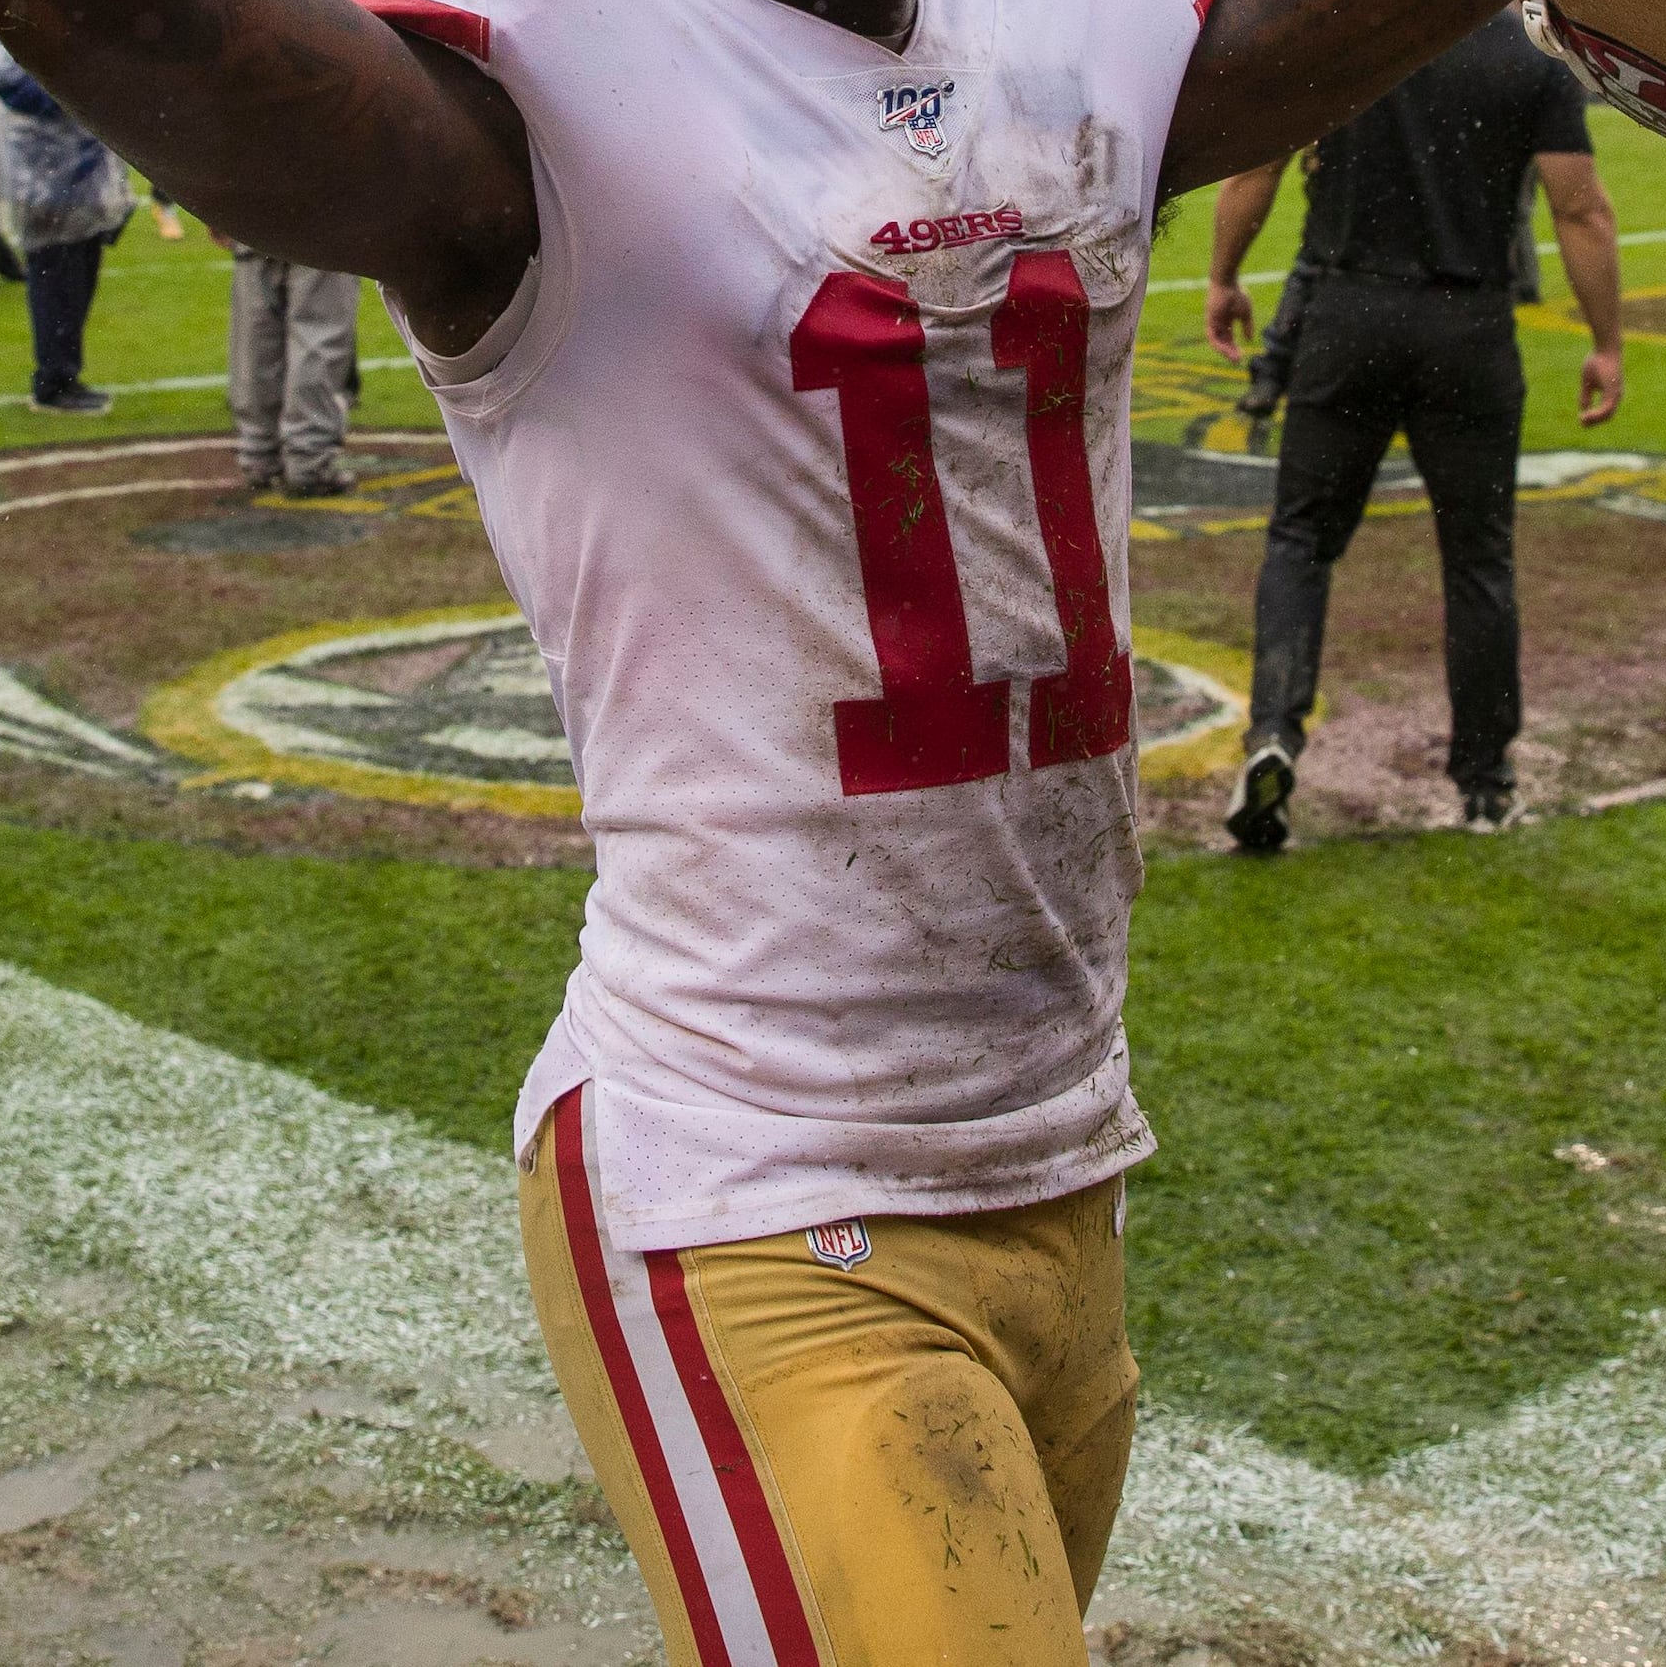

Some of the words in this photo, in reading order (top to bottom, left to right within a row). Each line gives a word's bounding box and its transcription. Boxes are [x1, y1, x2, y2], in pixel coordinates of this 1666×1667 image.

[914, 128, 942, 147] NFL
[869, 208, 1024, 256] 49ERS
[789, 249, 1131, 797] 11
[817, 1223, 864, 1257] NFL
